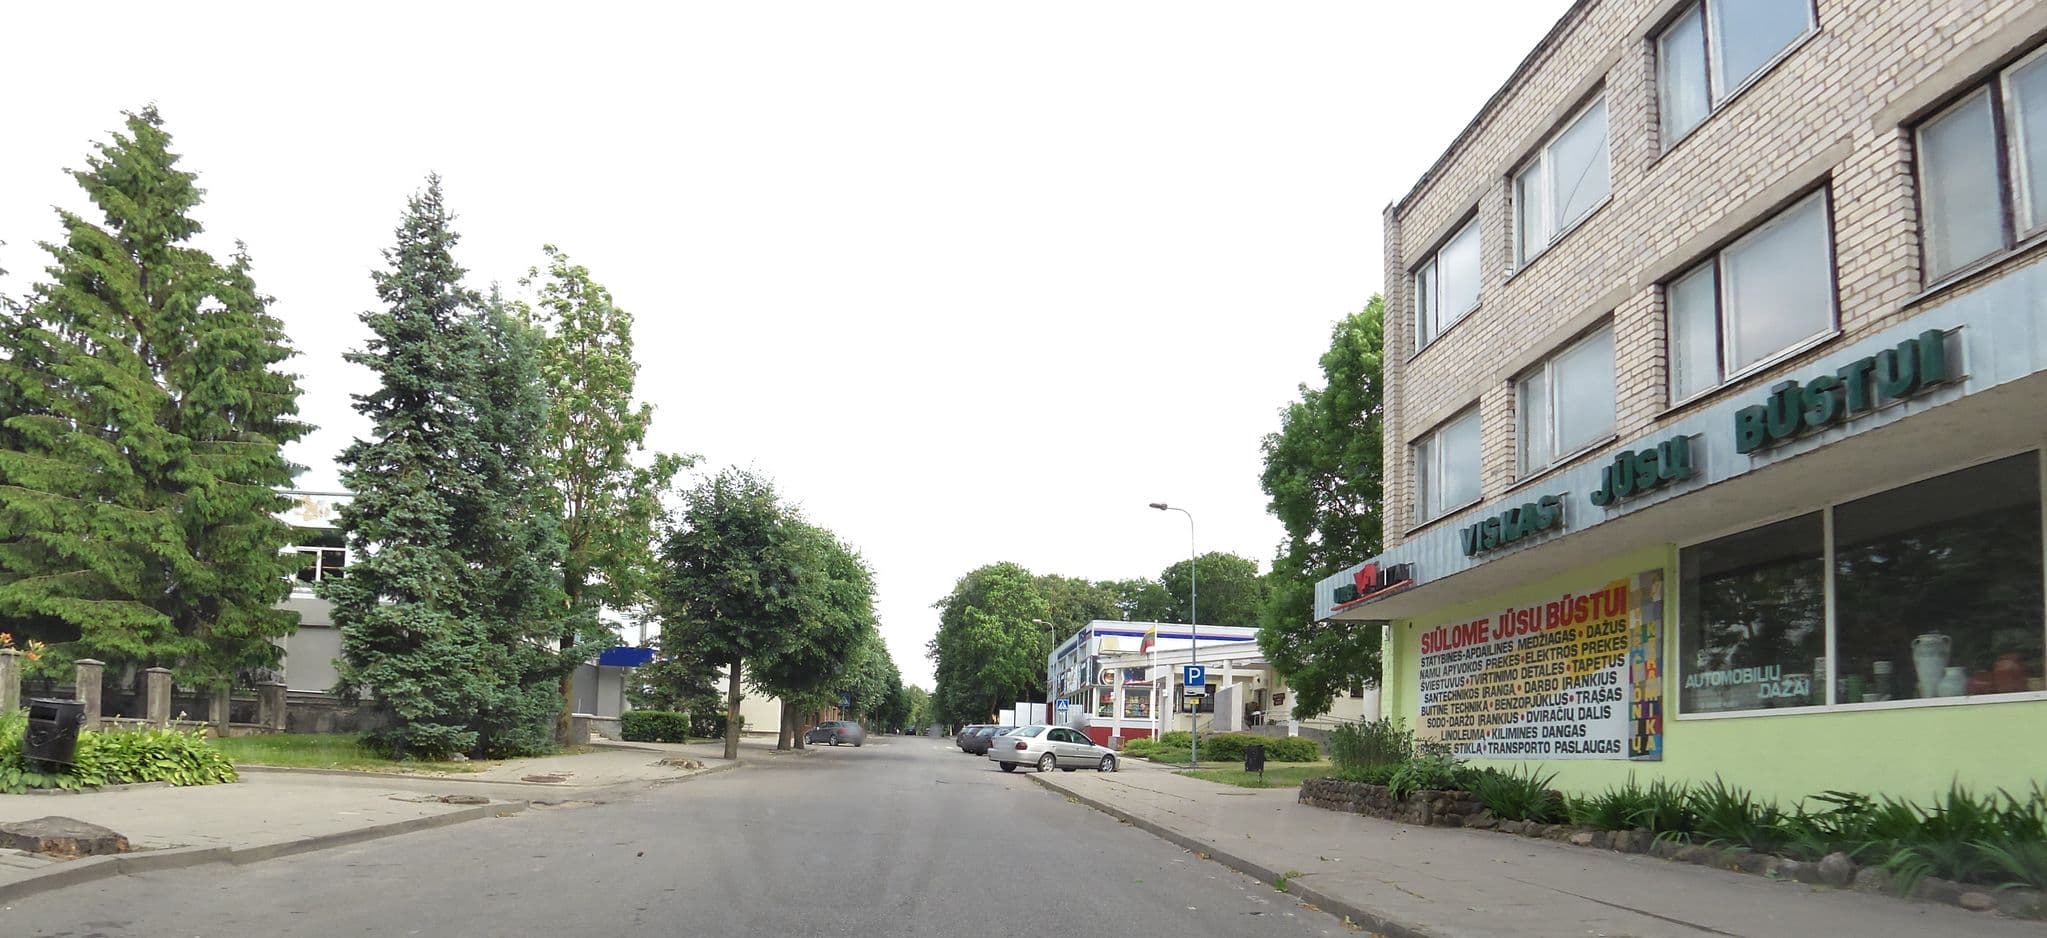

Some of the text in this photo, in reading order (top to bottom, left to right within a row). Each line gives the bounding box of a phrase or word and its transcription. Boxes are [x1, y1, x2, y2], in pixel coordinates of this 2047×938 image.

[1459, 329, 1945, 556] VISKAS JŪSŲ BŪSTUI
[1421, 618, 1489, 654] SIŪLOME
[1546, 585, 1627, 629] BŪSTUI
[1518, 628, 1576, 651] MEDŽIAGAS
[1586, 618, 1627, 638] DAŽUS
[1443, 660, 1482, 676] APYVOKOS
[1486, 654, 1521, 670] PREKES
[1525, 644, 1578, 664] ELEKTROS
[1581, 635, 1628, 655] PREKES
[1469, 668, 1518, 686] TVIRTINIMO
[1521, 662, 1565, 679] DETALES
[1571, 653, 1625, 672] TAPETUS
[1189, 667, 1201, 684] P
[1424, 687, 1479, 703] SANTECHNIKOS
[1525, 678, 1559, 694] DARBO
[1578, 705, 1611, 720] DALIS
[1487, 741, 1551, 754] TRANSPORTO
[1554, 739, 1622, 754] PASLAUGAS
[1491, 726, 1538, 740] KILIMINES
[1542, 724, 1587, 739] DANGAS
